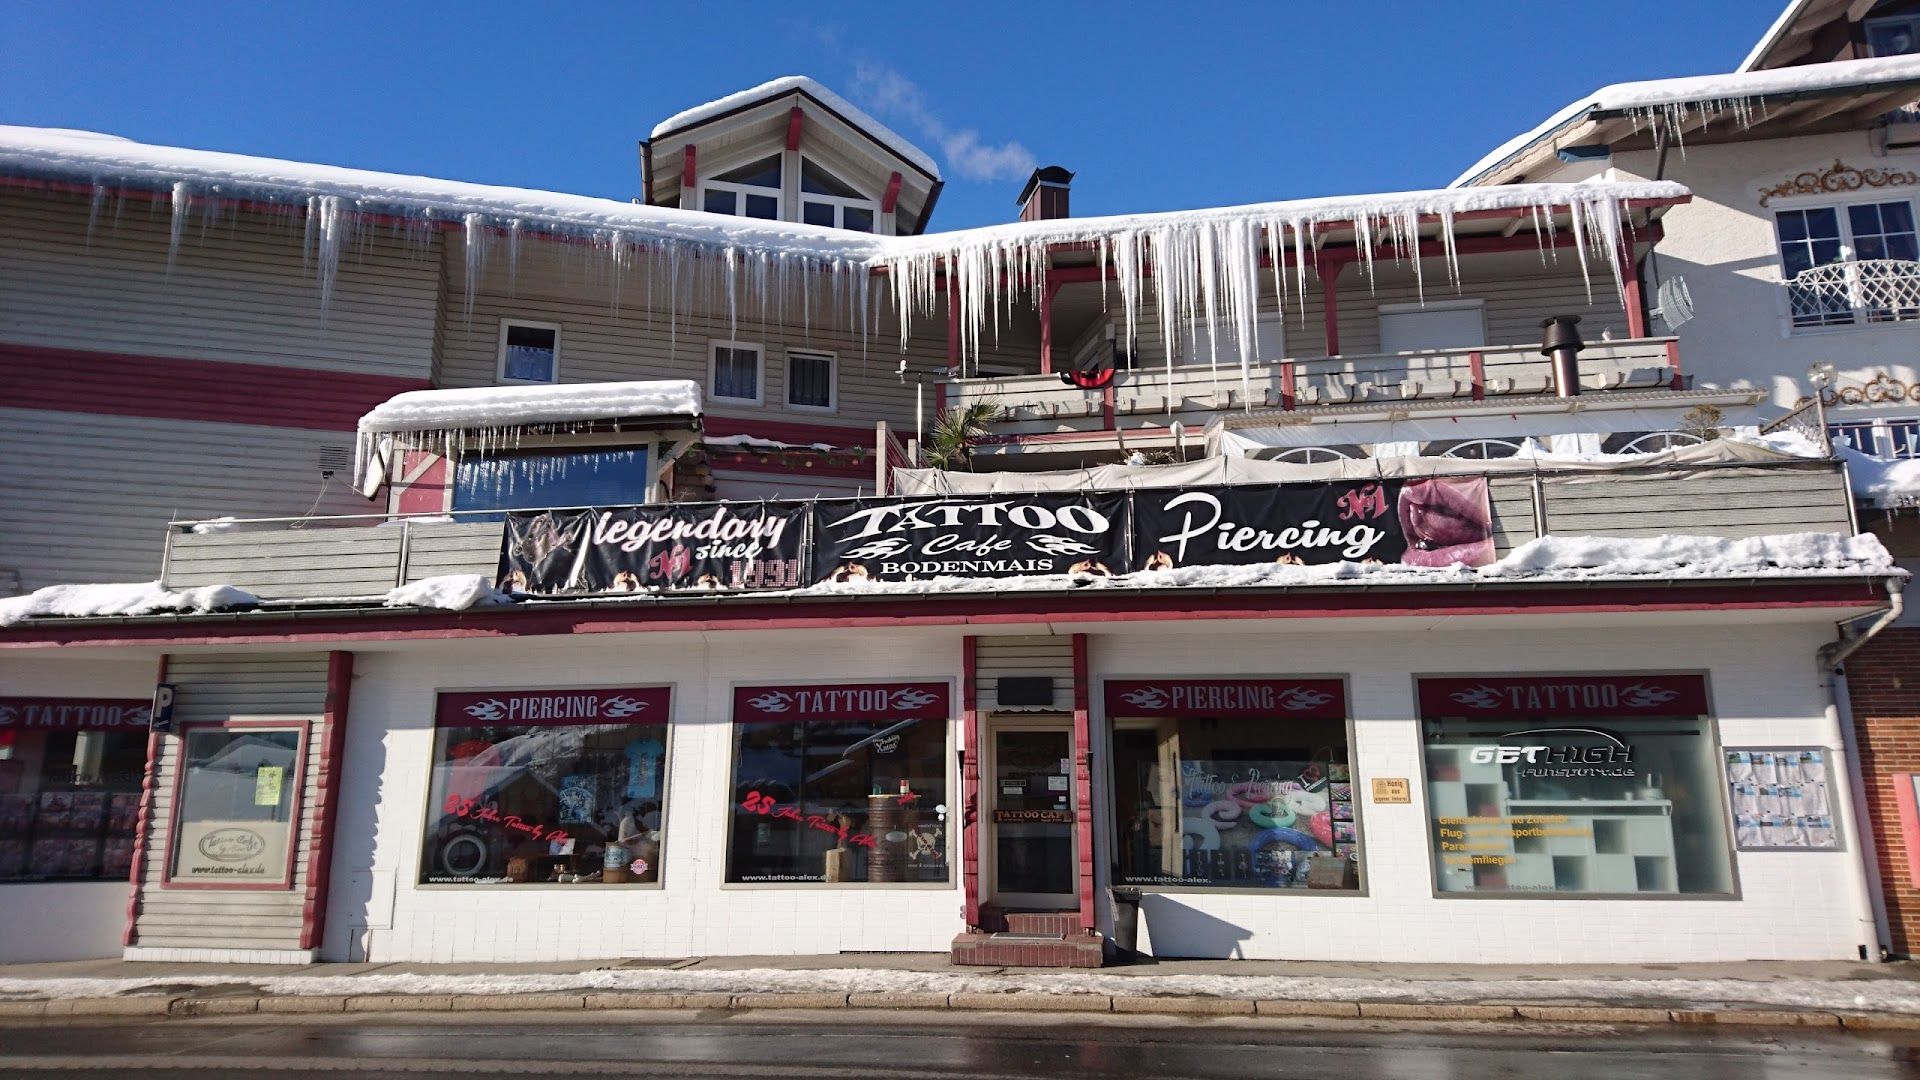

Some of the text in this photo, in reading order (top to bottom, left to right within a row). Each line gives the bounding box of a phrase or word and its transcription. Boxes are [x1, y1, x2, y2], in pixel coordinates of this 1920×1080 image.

[592, 506, 788, 551] legendary
[826, 499, 1110, 543] TATTOO
[1159, 492, 1385, 563] Piercing
[695, 539, 763, 560] since
[921, 534, 1012, 556] Cafe
[729, 559, 799, 588] 1991
[880, 559, 1053, 574] BODENMAIS
[157, 686, 173, 717] P
[508, 696, 598, 720] PIERCING
[795, 690, 887, 713] TATTOO
[1172, 686, 1274, 709] PIERCING
[1507, 684, 1618, 709] TATTOO
[23, 704, 122, 726] TATTOO
[443, 793, 474, 817] 25
[742, 790, 776, 815] 25
[995, 811, 1039, 822] TATTOO
